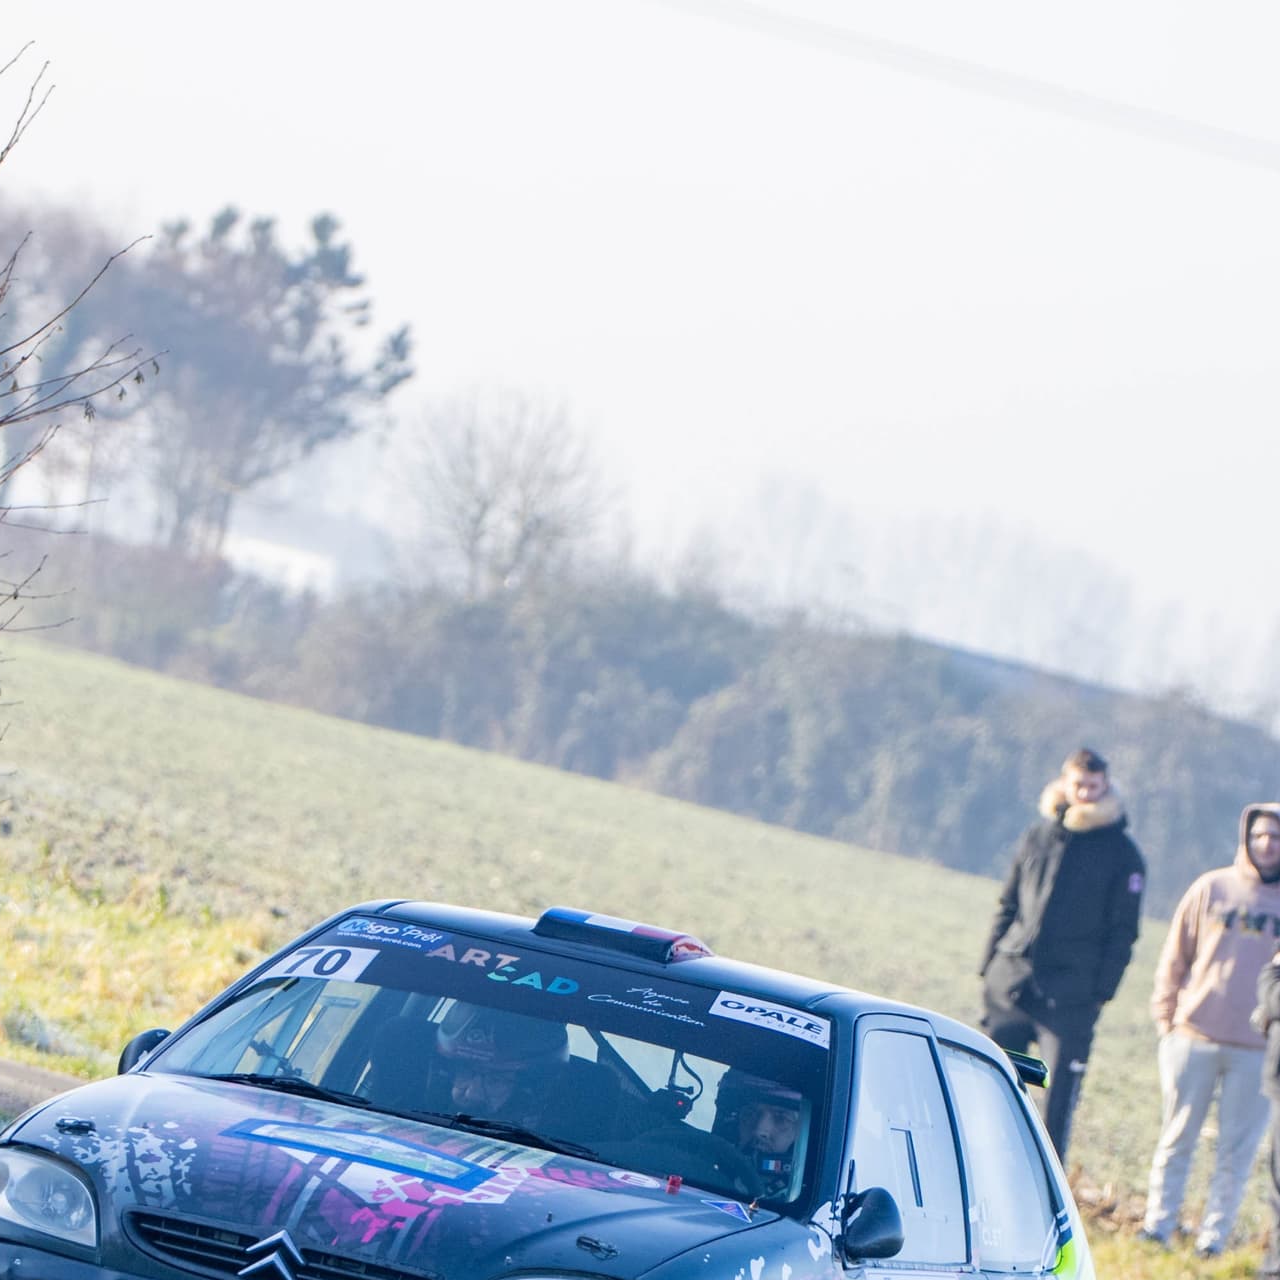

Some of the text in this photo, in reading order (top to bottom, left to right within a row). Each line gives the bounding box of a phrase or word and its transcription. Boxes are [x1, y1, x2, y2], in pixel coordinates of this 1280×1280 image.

[283, 948, 353, 977] 70
[424, 943, 520, 969] ART
[720, 999, 825, 1036] OPALE
